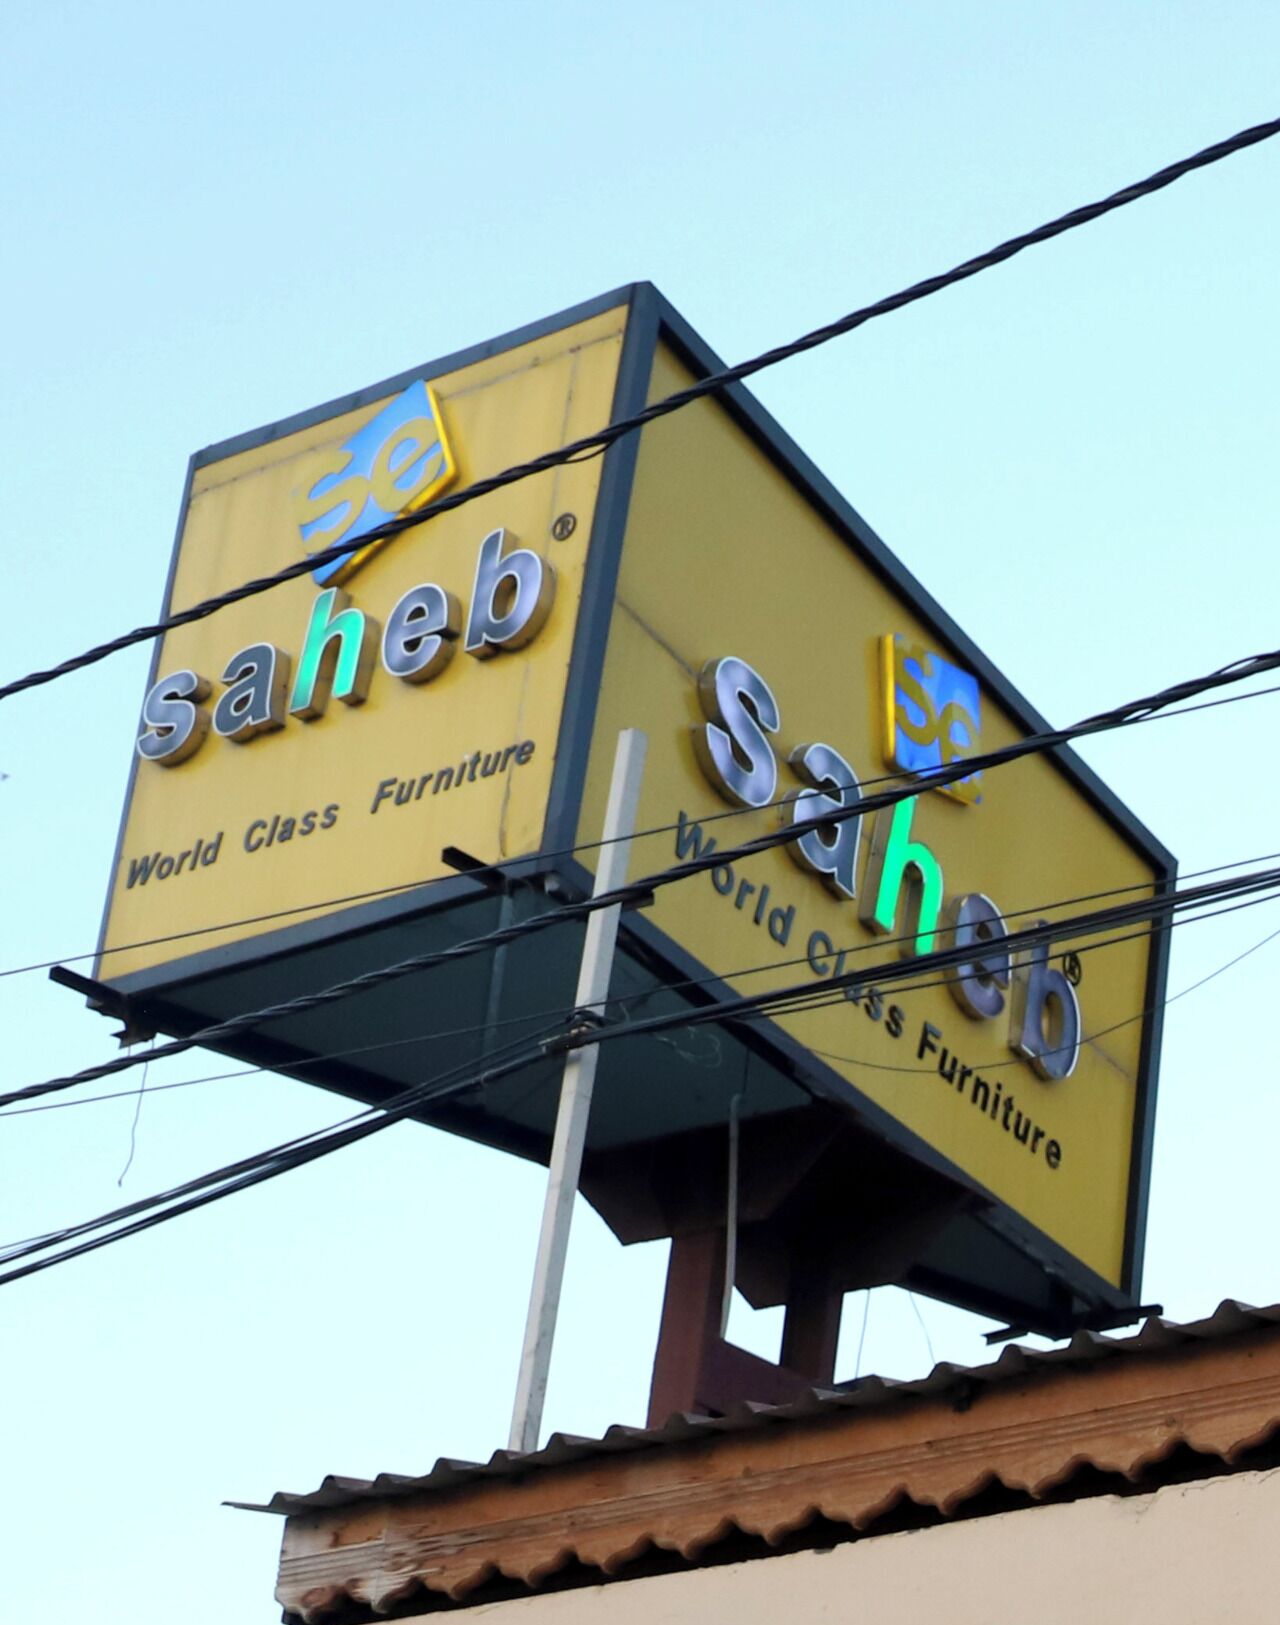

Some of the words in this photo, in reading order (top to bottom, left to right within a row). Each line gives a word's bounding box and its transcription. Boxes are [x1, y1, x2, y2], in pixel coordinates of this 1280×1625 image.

[126, 832, 223, 889] World
[244, 804, 339, 853] Class
[370, 740, 536, 814] Furniture
[675, 810, 796, 946] World
[917, 1021, 1062, 1170] Furniture
